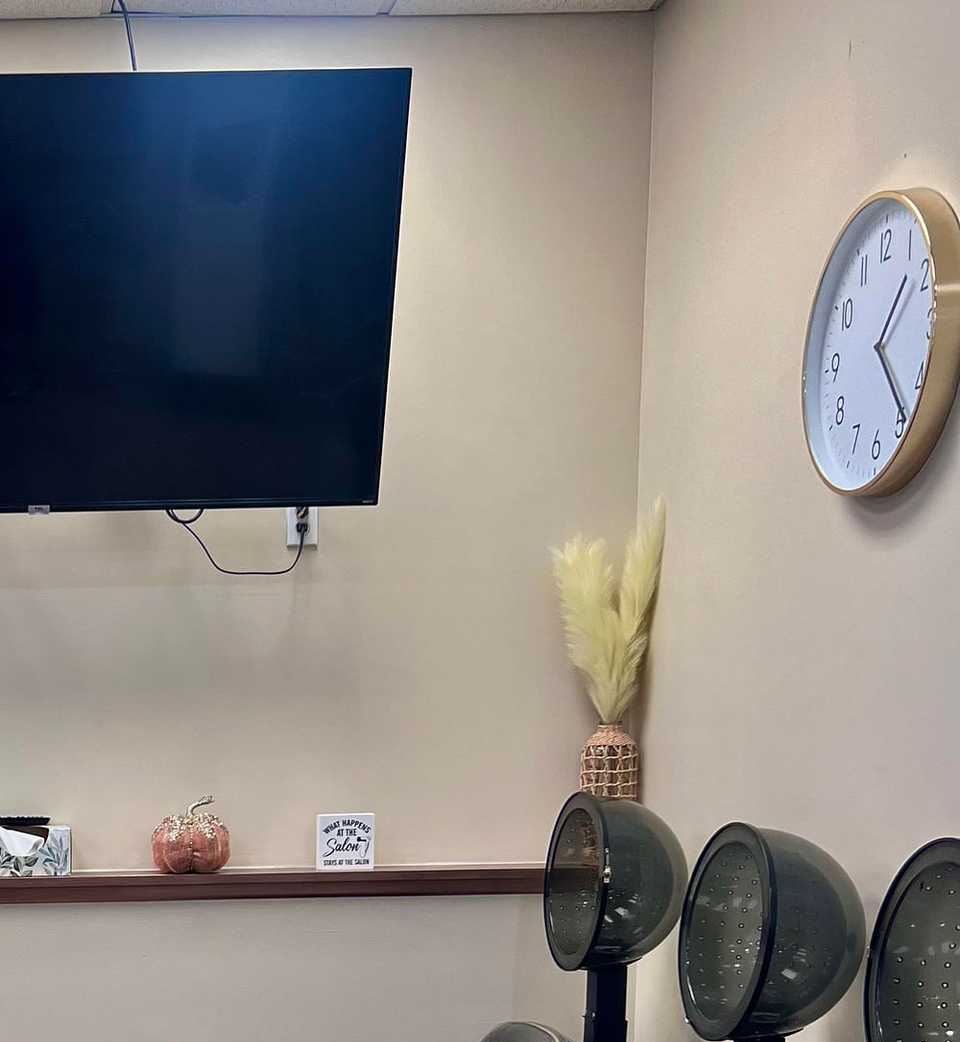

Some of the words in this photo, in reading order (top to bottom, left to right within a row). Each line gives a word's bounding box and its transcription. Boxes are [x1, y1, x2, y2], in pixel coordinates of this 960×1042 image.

[879, 229, 892, 263] 12
[907, 229, 913, 261] 1
[860, 254, 868, 288] 11
[919, 258, 929, 292] 2
[841, 297, 853, 332] 10
[830, 352, 840, 383] 9
[835, 395, 845, 426] 8
[852, 423, 861, 455] 7
[871, 429, 881, 460] 6
[323, 820, 341, 834] WHAT
[342, 819, 372, 834] HAPPENS
[322, 836, 359, 858] Salon
